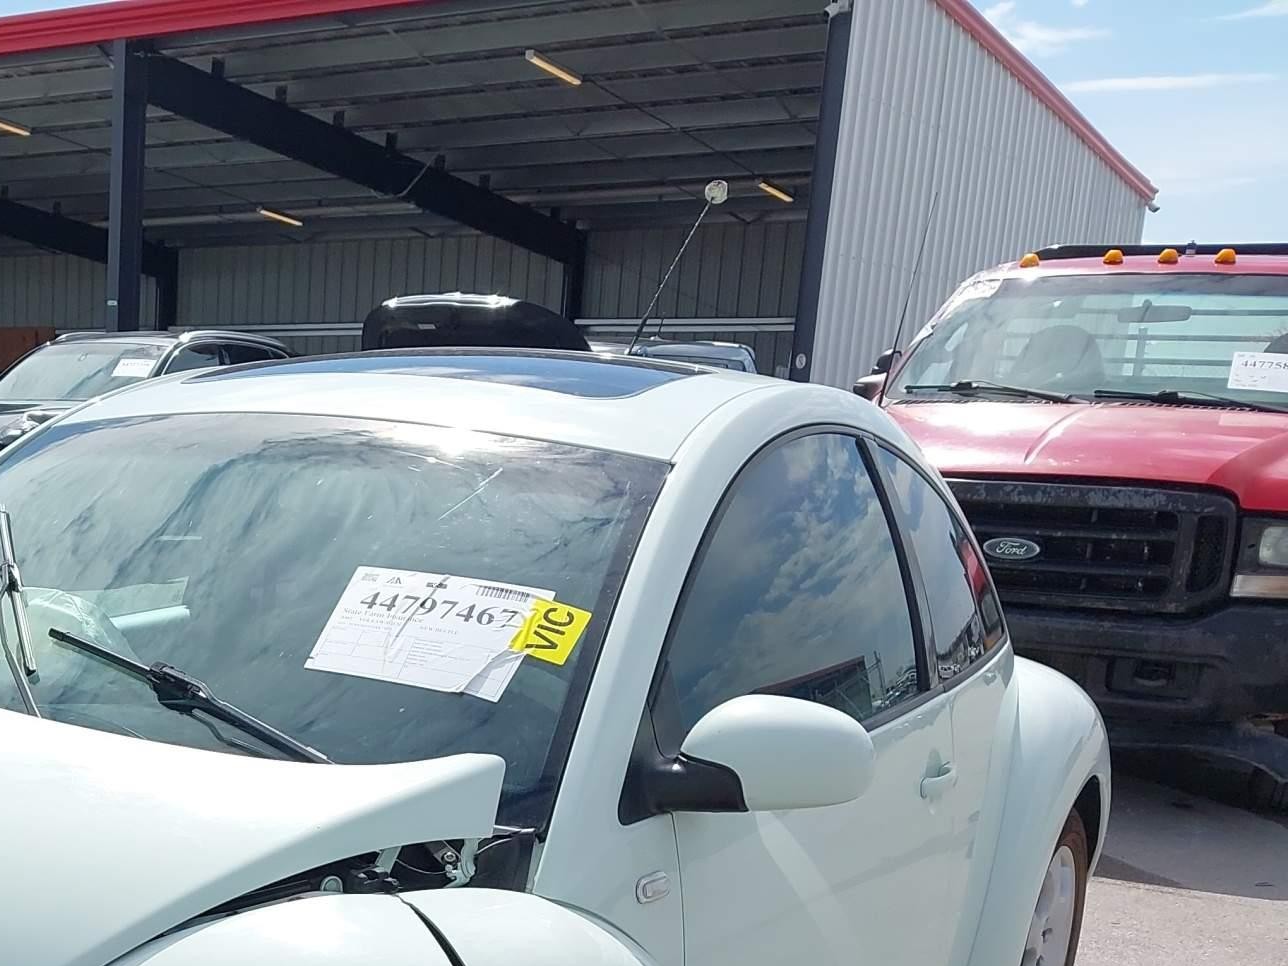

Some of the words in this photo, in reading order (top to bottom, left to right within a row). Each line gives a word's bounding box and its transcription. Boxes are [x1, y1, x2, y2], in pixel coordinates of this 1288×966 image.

[996, 541, 1028, 555] Ford
[360, 591, 518, 628] 44797467
[525, 607, 575, 650] VIC
